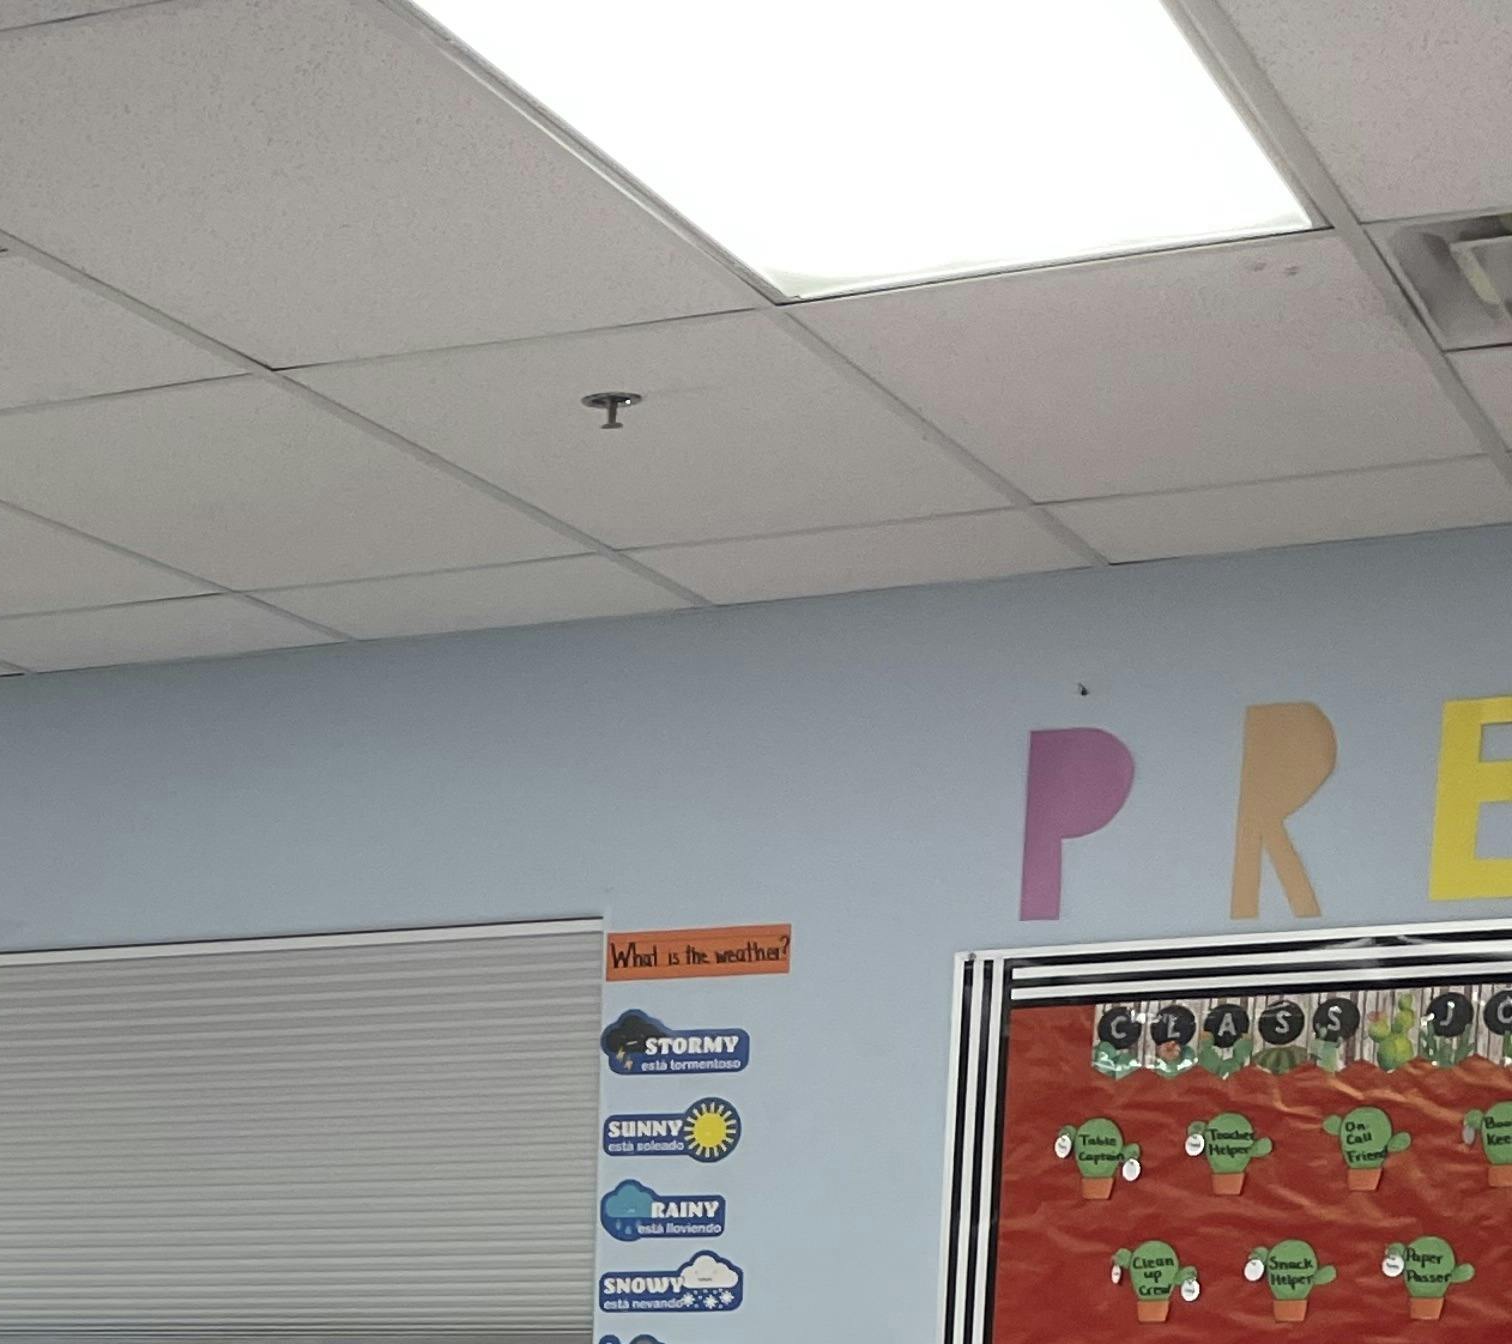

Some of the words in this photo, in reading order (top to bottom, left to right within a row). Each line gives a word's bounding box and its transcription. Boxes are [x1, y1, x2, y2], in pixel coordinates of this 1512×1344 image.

[610, 942, 658, 968] What
[668, 952, 680, 966] is
[686, 944, 710, 965] the
[715, 935, 791, 965] weather?
[1110, 1005, 1341, 1040] CLASS
[645, 1036, 739, 1055] STORMY
[641, 1059, 667, 1072] está
[670, 1058, 741, 1071] tormentoso
[608, 1120, 683, 1138] SUNNY
[1345, 1122, 1365, 1132] On
[1079, 1134, 1117, 1146] Table
[1207, 1129, 1256, 1141] Teacher
[1346, 1132, 1372, 1145] Call
[608, 1141, 634, 1151] está
[637, 1140, 685, 1151] soleado
[1209, 1144, 1249, 1158] Helper
[1079, 1152, 1125, 1165] Captain
[1346, 1146, 1387, 1163] Friend
[651, 1201, 719, 1218] RAINY
[638, 1223, 664, 1234] está
[666, 1222, 722, 1234] lloviendo
[1133, 1257, 1174, 1269] Clean
[1269, 1258, 1313, 1270] Snack
[1404, 1247, 1443, 1268] Paper
[1144, 1271, 1162, 1283] up
[1270, 1274, 1314, 1289] Helper
[1406, 1269, 1452, 1282] Passer
[604, 1277, 685, 1294] SNOWY
[1139, 1284, 1171, 1296] Crew
[604, 1299, 629, 1310] está
[632, 1299, 683, 1309] nevando
